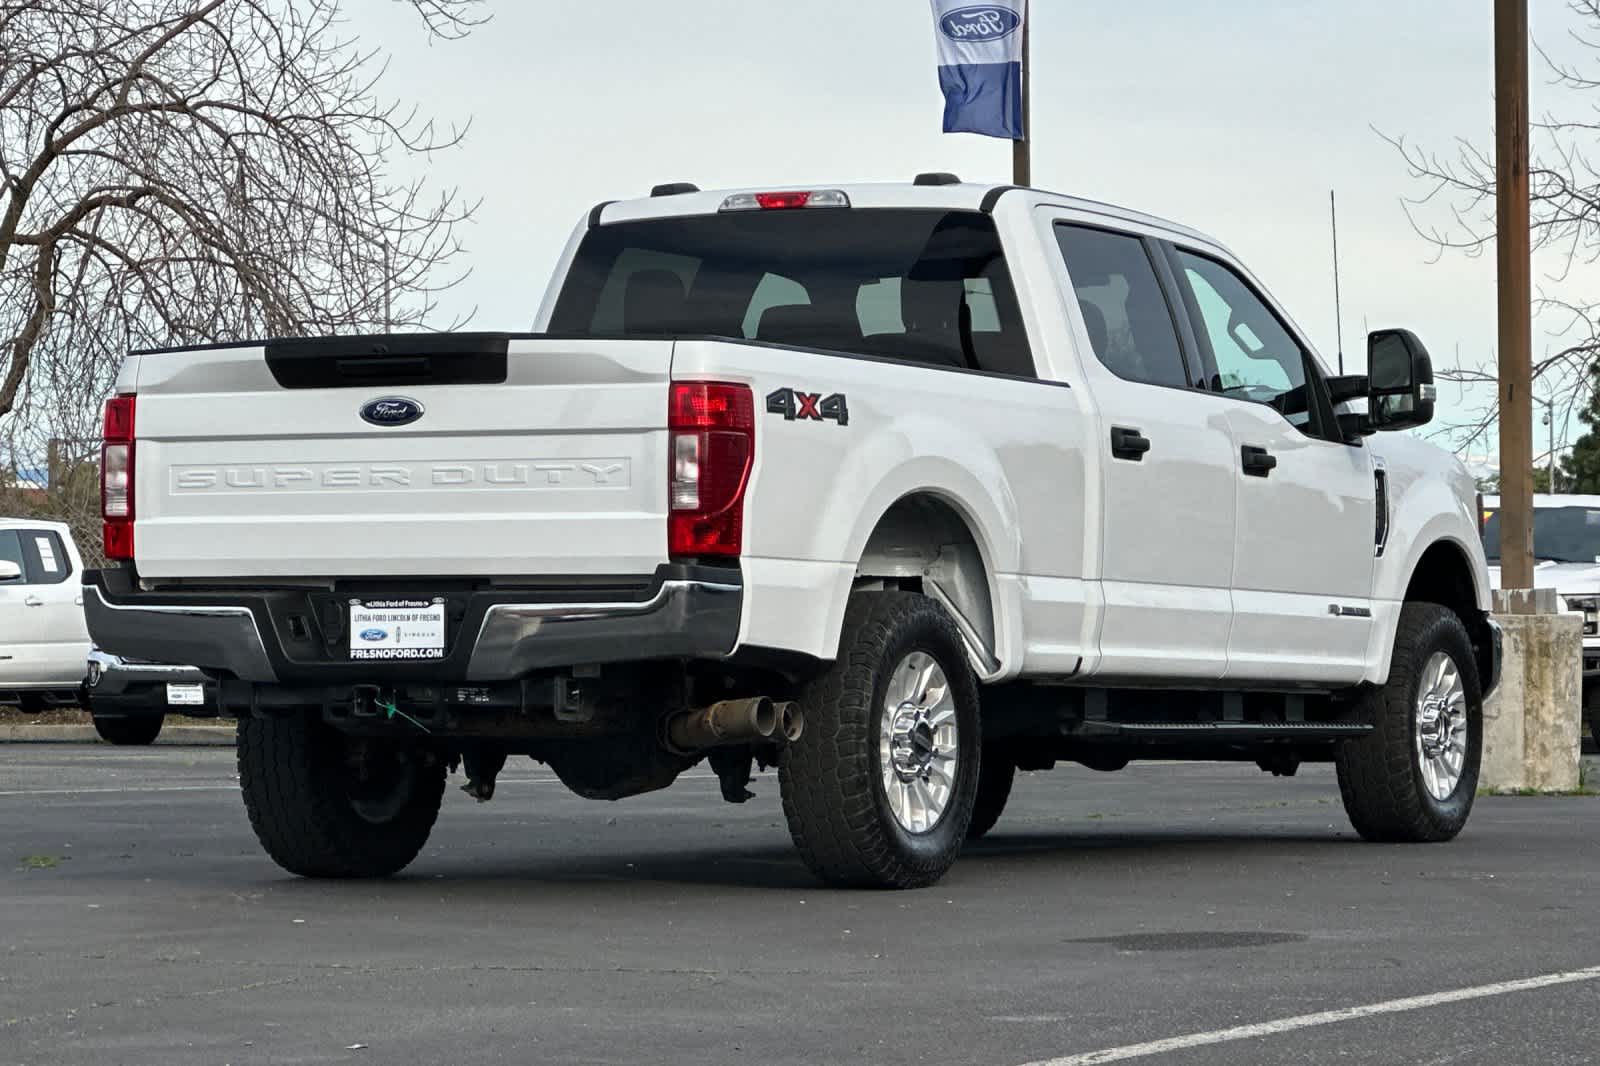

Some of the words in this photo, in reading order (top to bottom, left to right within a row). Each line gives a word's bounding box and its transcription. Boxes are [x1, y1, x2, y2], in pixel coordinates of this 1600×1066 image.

[372, 401, 408, 419] Ford
[176, 464, 411, 489] SUPER
[431, 462, 623, 485] DUTY
[354, 614, 371, 622] LITHIA
[373, 614, 386, 622] FORD
[388, 614, 411, 622] LINCOLN
[412, 614, 418, 622] OF
[420, 614, 441, 622] FRESNO
[350, 649, 443, 659] FRESNOFORD.COM
